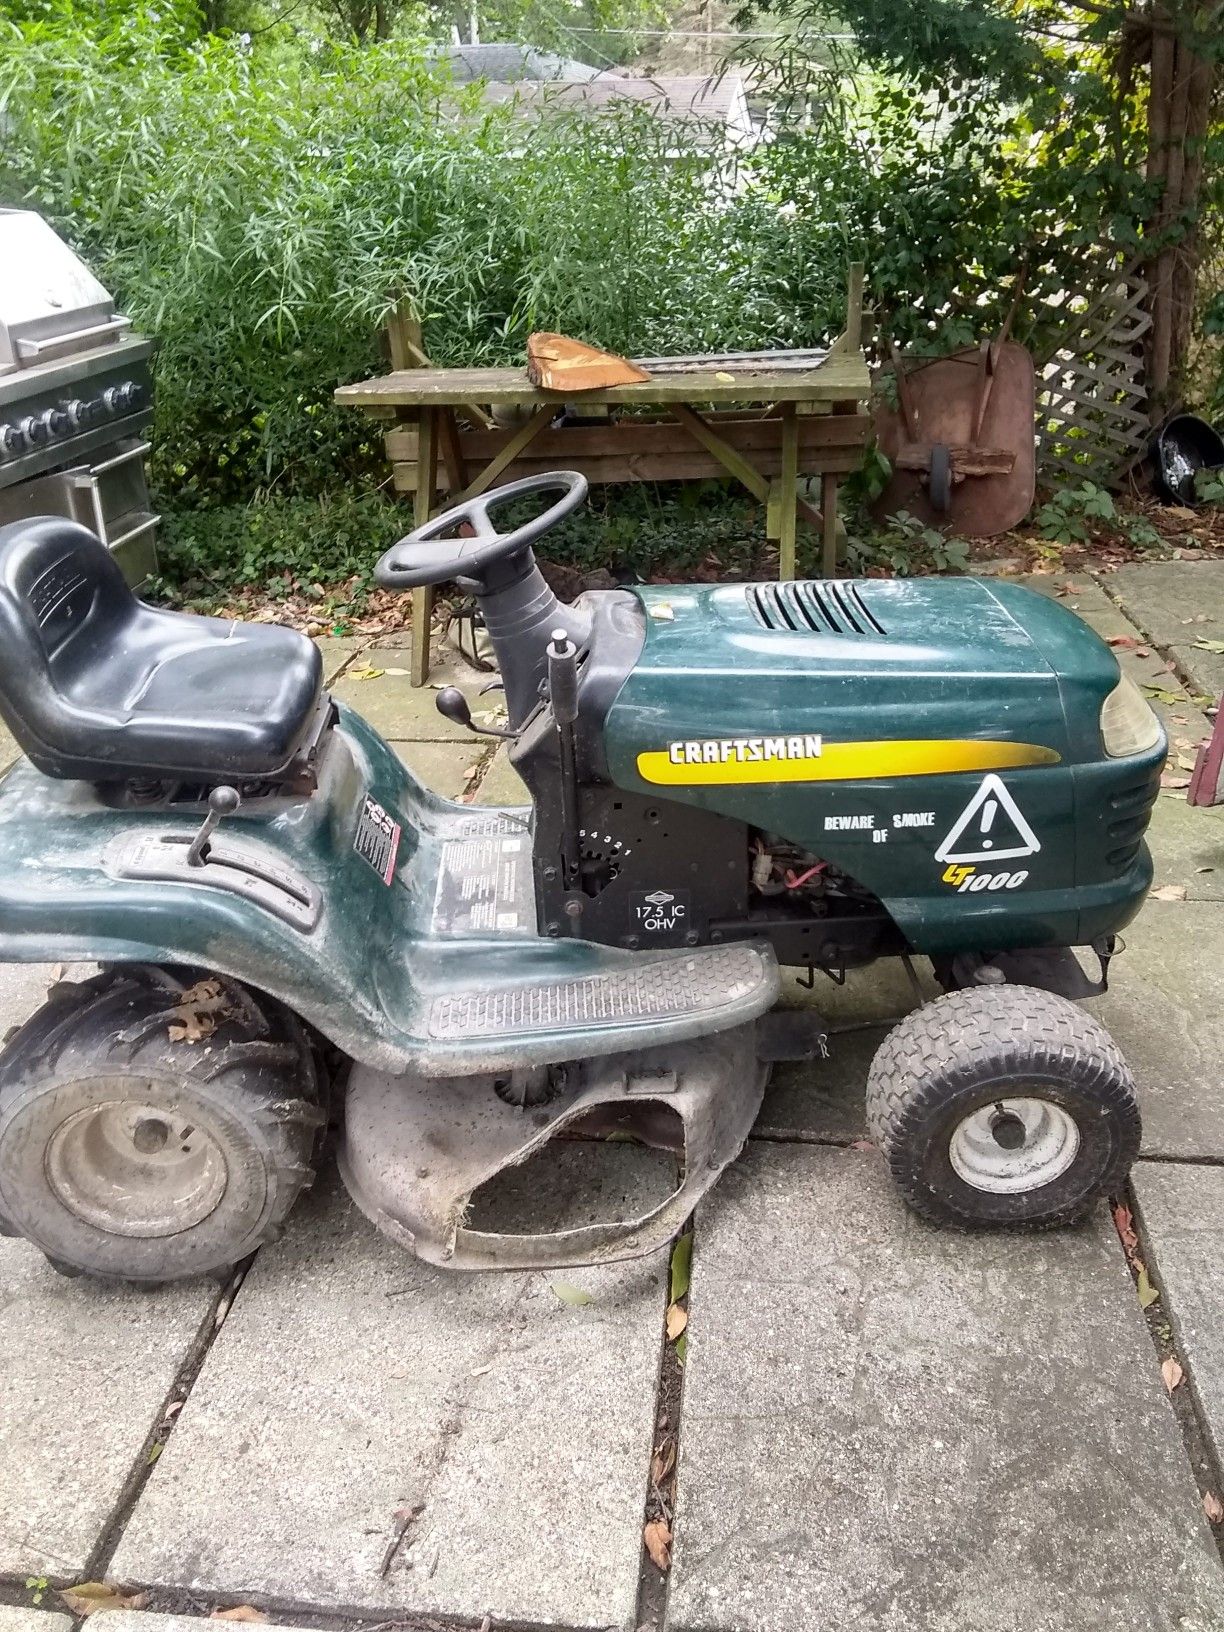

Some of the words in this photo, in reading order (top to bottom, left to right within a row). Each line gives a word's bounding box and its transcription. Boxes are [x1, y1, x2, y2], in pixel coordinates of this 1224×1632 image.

[669, 734, 823, 764] CRAFTSMAN
[824, 814, 875, 831] BEWARE
[892, 812, 936, 829] SMOKE
[579, 829, 586, 837] 5
[590, 831, 598, 839] 4
[603, 835, 612, 843] 3
[613, 841, 623, 849] 2
[872, 829, 888, 843] OF
[942, 864, 1029, 893] LT1000
[636, 906, 664, 918] 17.5
[671, 905, 685, 917] IC
[644, 918, 676, 930] OHV
